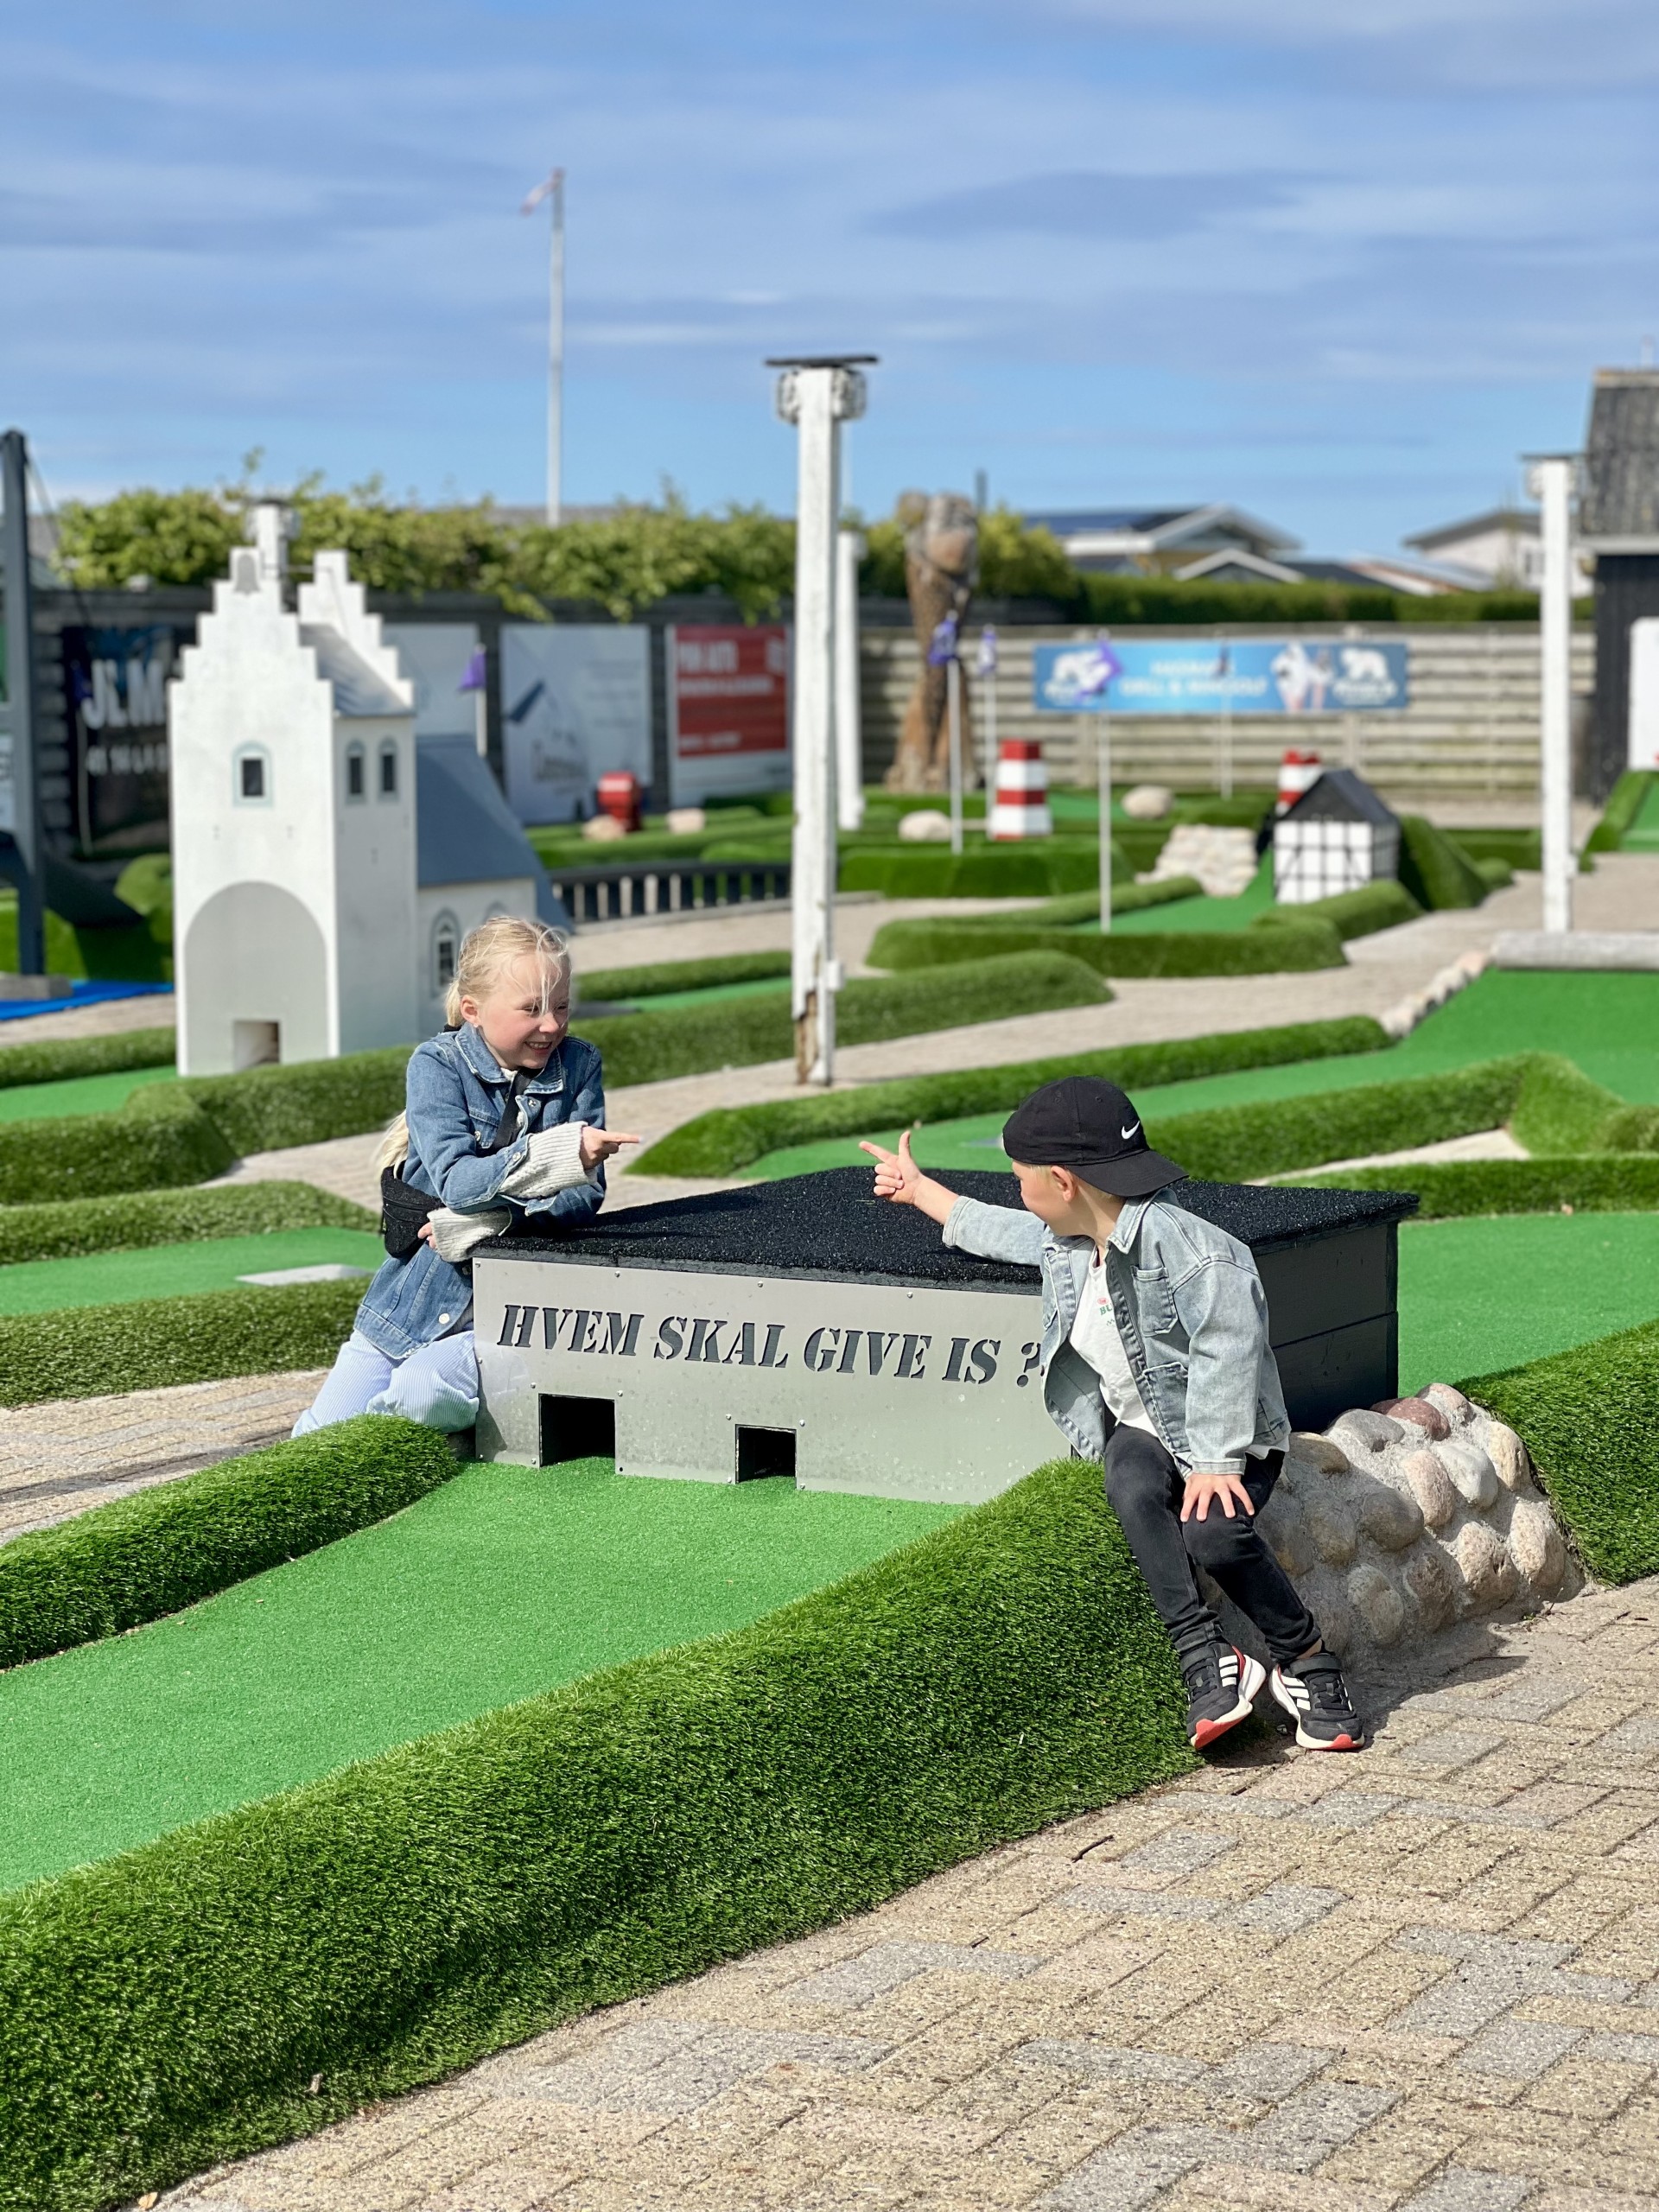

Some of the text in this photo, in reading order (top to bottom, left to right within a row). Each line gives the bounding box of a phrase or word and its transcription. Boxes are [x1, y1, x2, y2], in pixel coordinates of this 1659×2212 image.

[497, 1304, 1041, 1388] HVEM SKAL GIVE IS ?
